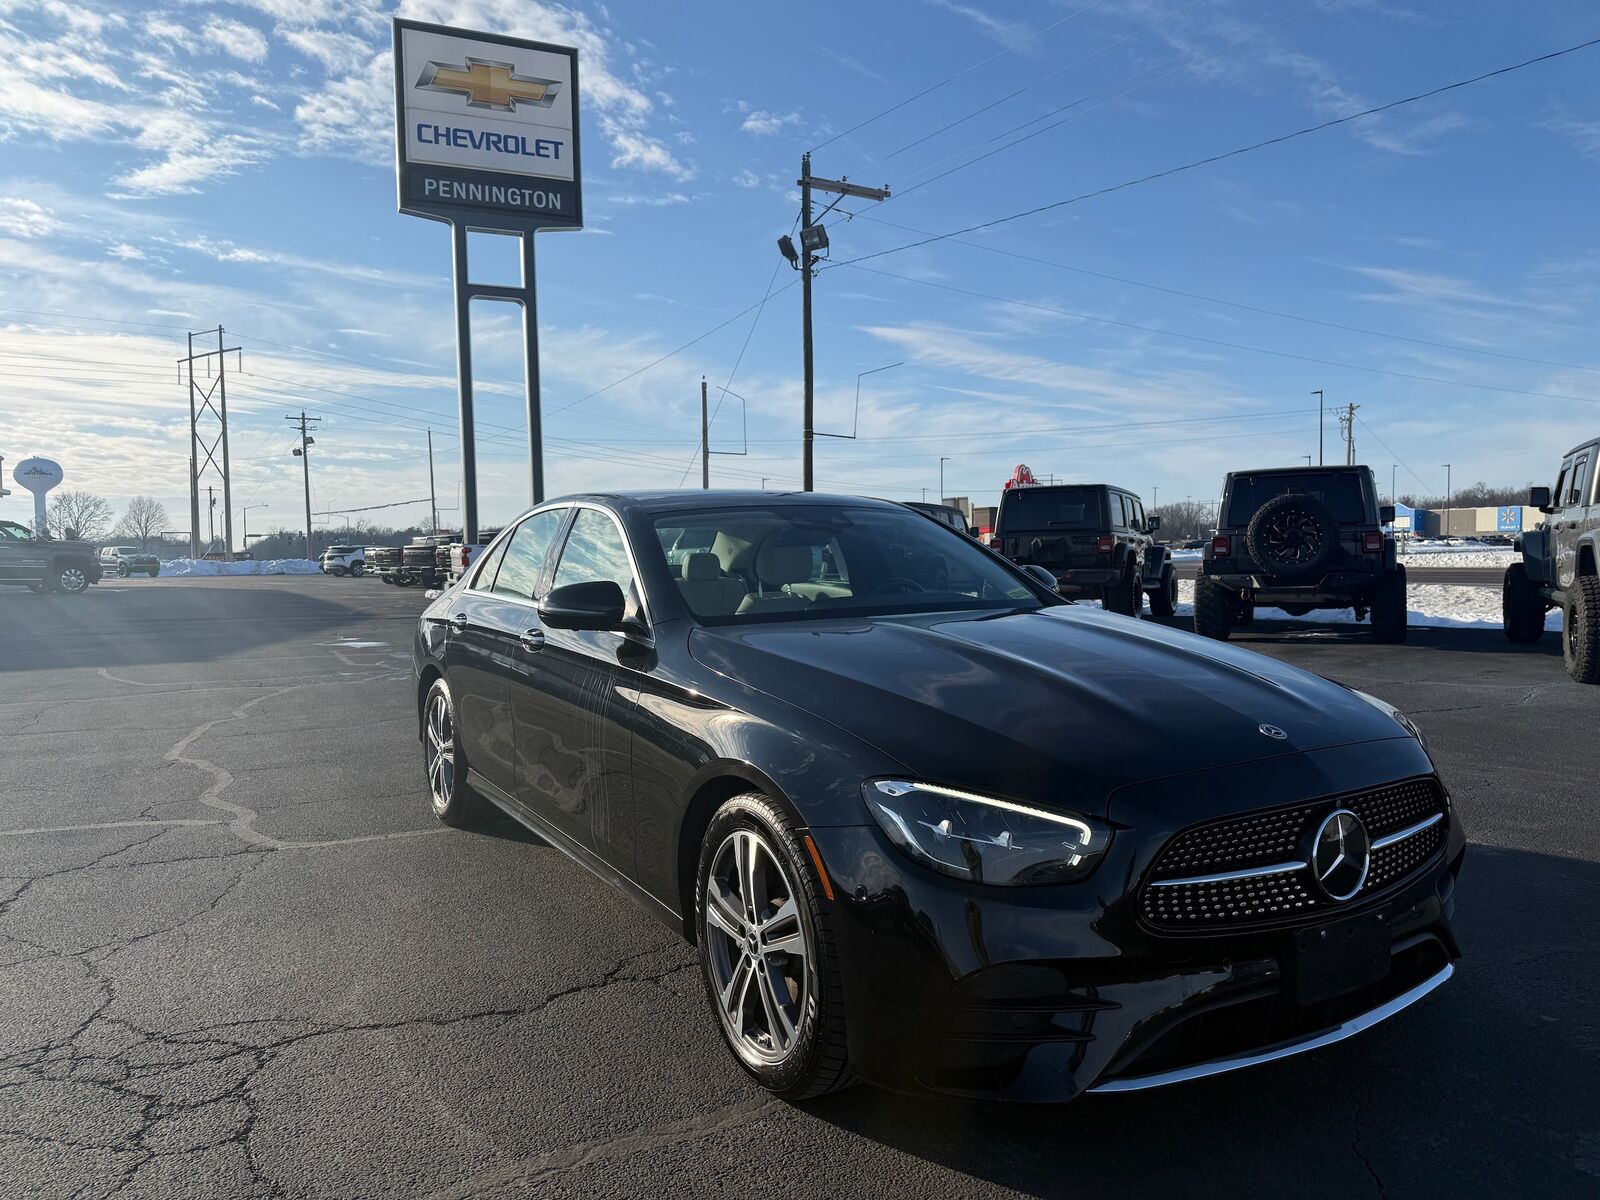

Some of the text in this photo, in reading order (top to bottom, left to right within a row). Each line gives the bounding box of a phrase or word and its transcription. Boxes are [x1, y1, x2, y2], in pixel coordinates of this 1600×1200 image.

[417, 123, 563, 159] CHEVROLET
[424, 178, 561, 210] PENNINGTON
[1012, 480, 1039, 489] Arby
